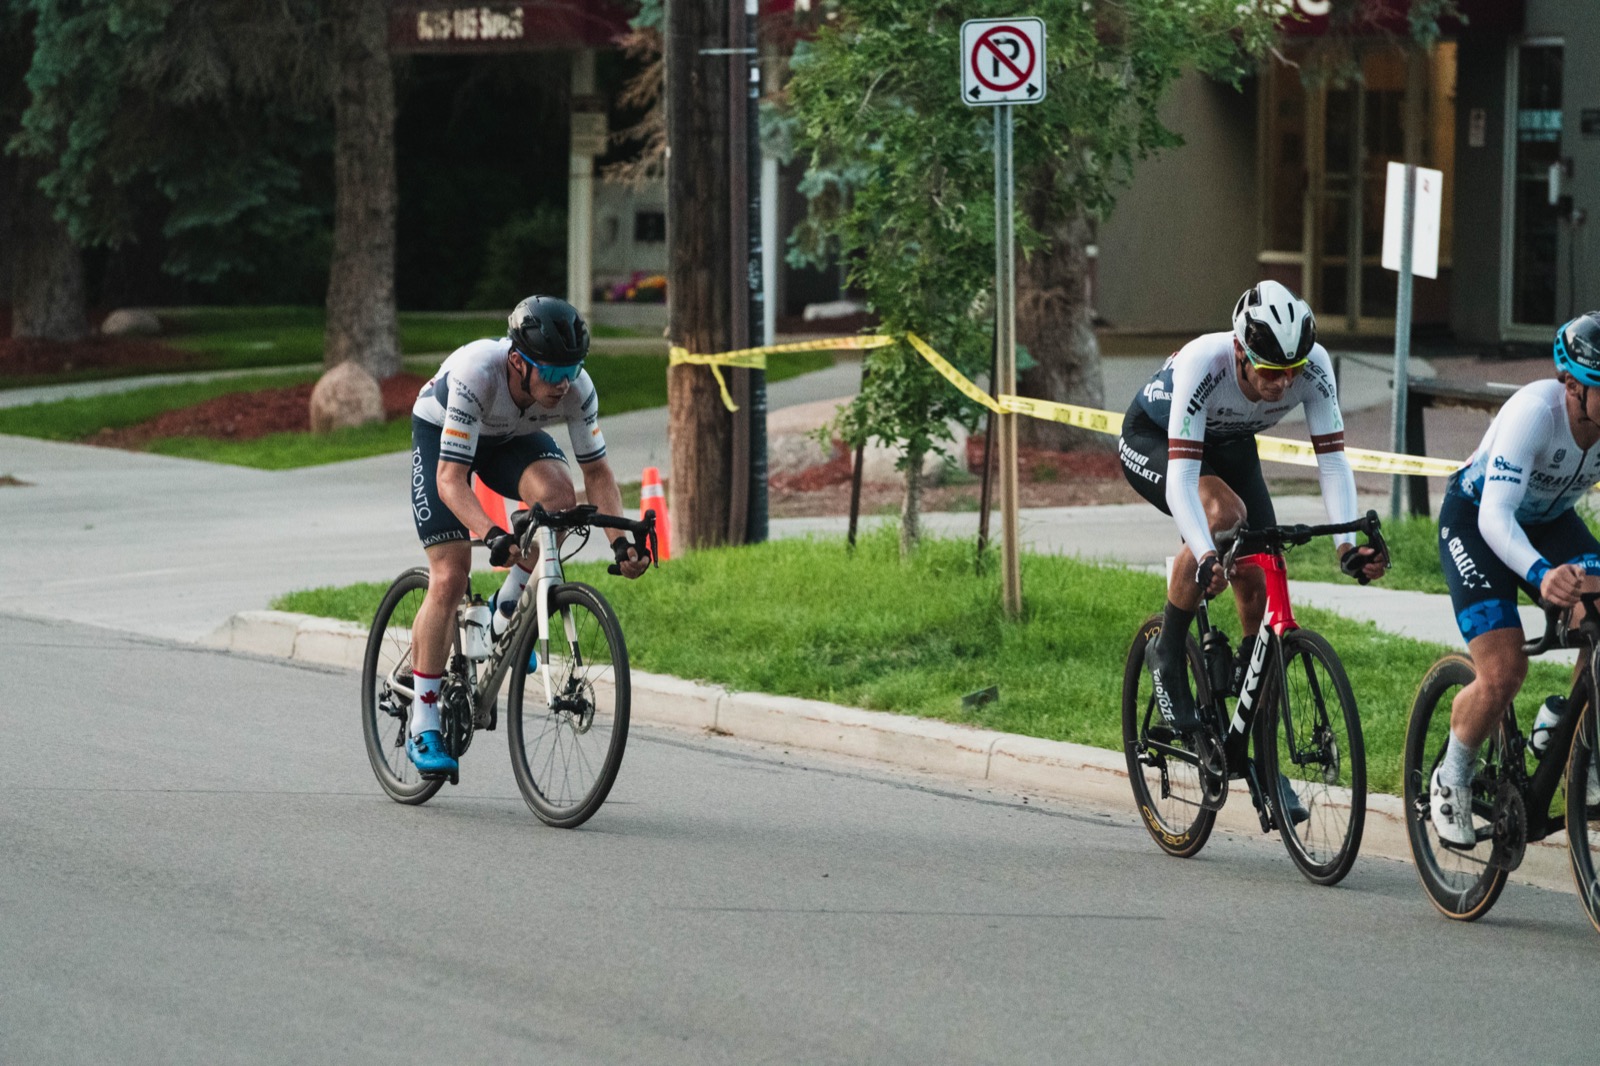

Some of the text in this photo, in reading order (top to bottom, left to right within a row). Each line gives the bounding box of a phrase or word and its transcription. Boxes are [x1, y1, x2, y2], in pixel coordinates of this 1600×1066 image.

[993, 38, 1020, 77] P
[1120, 452, 1163, 484] PROJECT
[1122, 443, 1150, 466] MIND
[412, 446, 431, 521] TORONTO
[1448, 537, 1475, 577] ISRAEL
[1228, 597, 1275, 735] TREK
[1142, 805, 1190, 845] YOELEO
